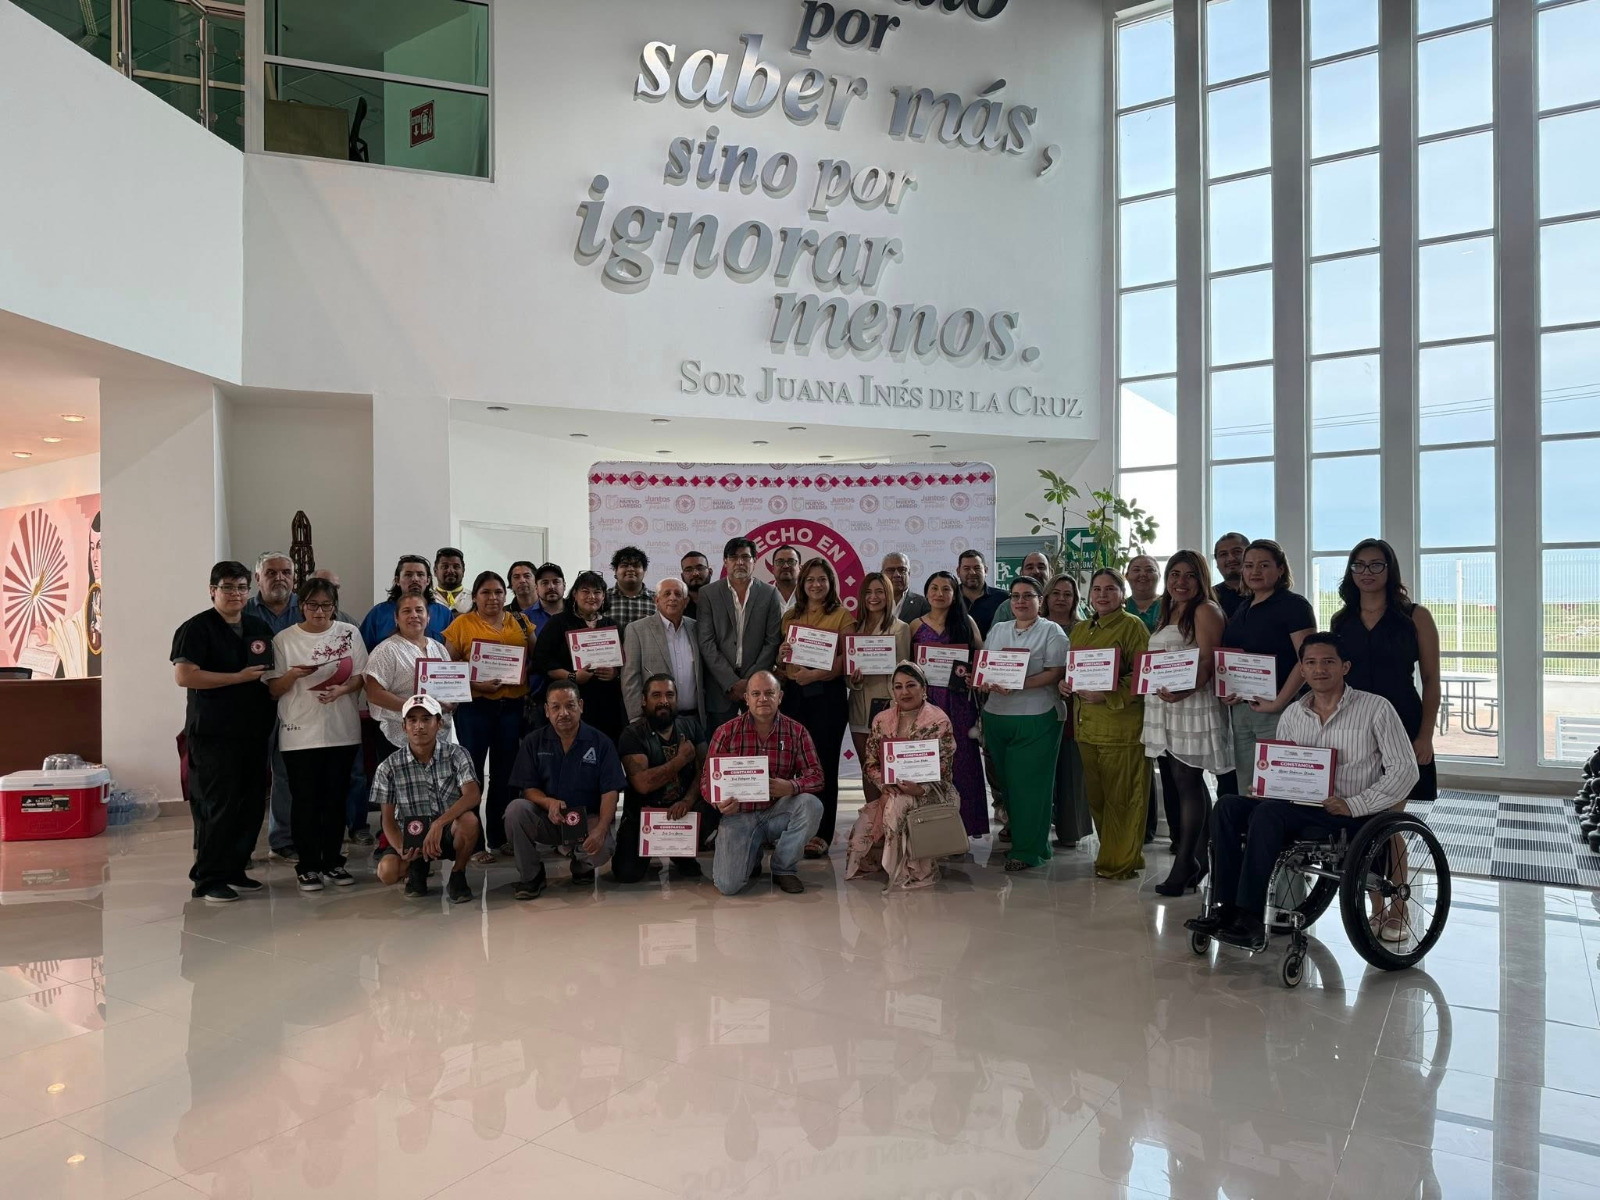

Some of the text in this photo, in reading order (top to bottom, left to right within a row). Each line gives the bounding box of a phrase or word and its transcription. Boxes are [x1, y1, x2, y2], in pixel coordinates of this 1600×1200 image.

[790, 0, 901, 55] por
[635, 34, 1061, 178] saber más,
[664, 125, 916, 214] sino por
[575, 174, 902, 284] ignorar
[770, 292, 1041, 363] menos.
[929, 388, 963, 411] DE
[969, 391, 1002, 413] LA
[753, 527, 846, 563] ECHO EN
